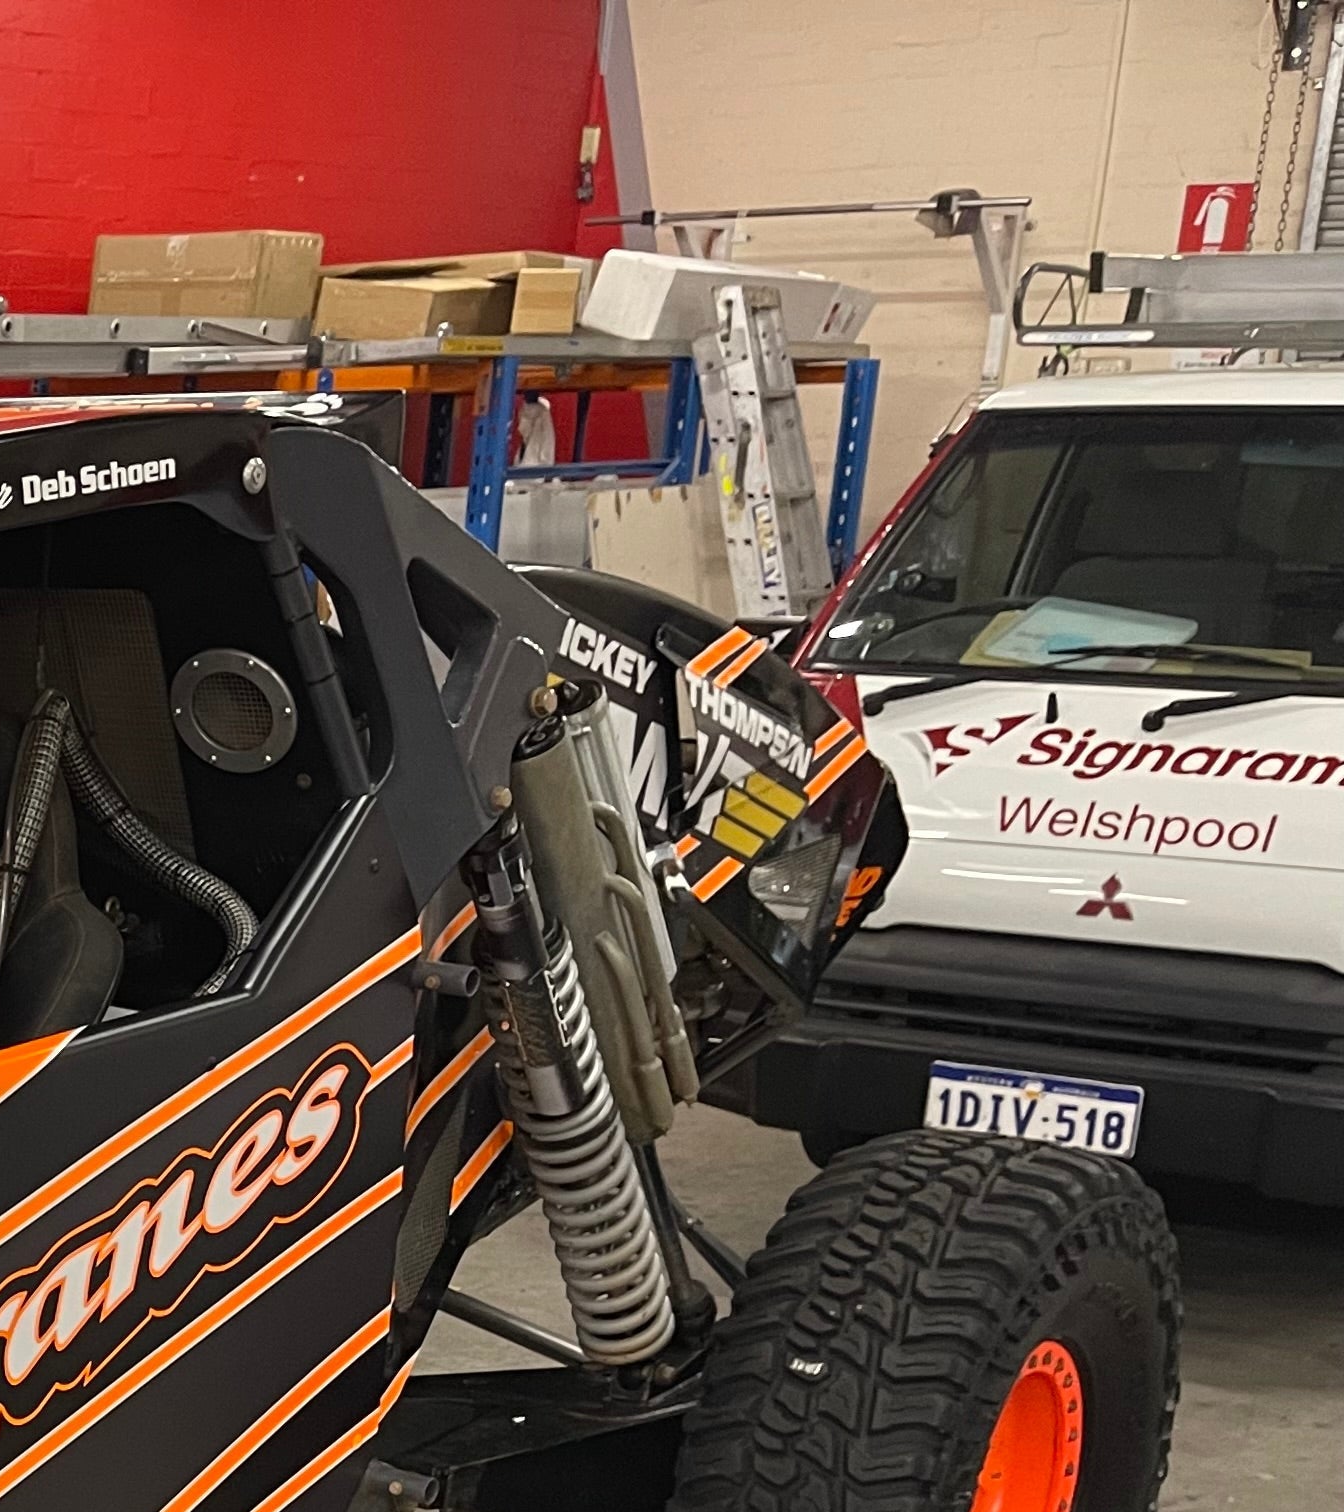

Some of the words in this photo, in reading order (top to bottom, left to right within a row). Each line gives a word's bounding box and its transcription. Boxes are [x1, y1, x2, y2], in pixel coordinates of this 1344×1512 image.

[21, 470, 76, 506] Deb
[80, 457, 177, 495] Schoen
[557, 617, 658, 695] ICKEY
[998, 795, 1279, 855] Welshpool
